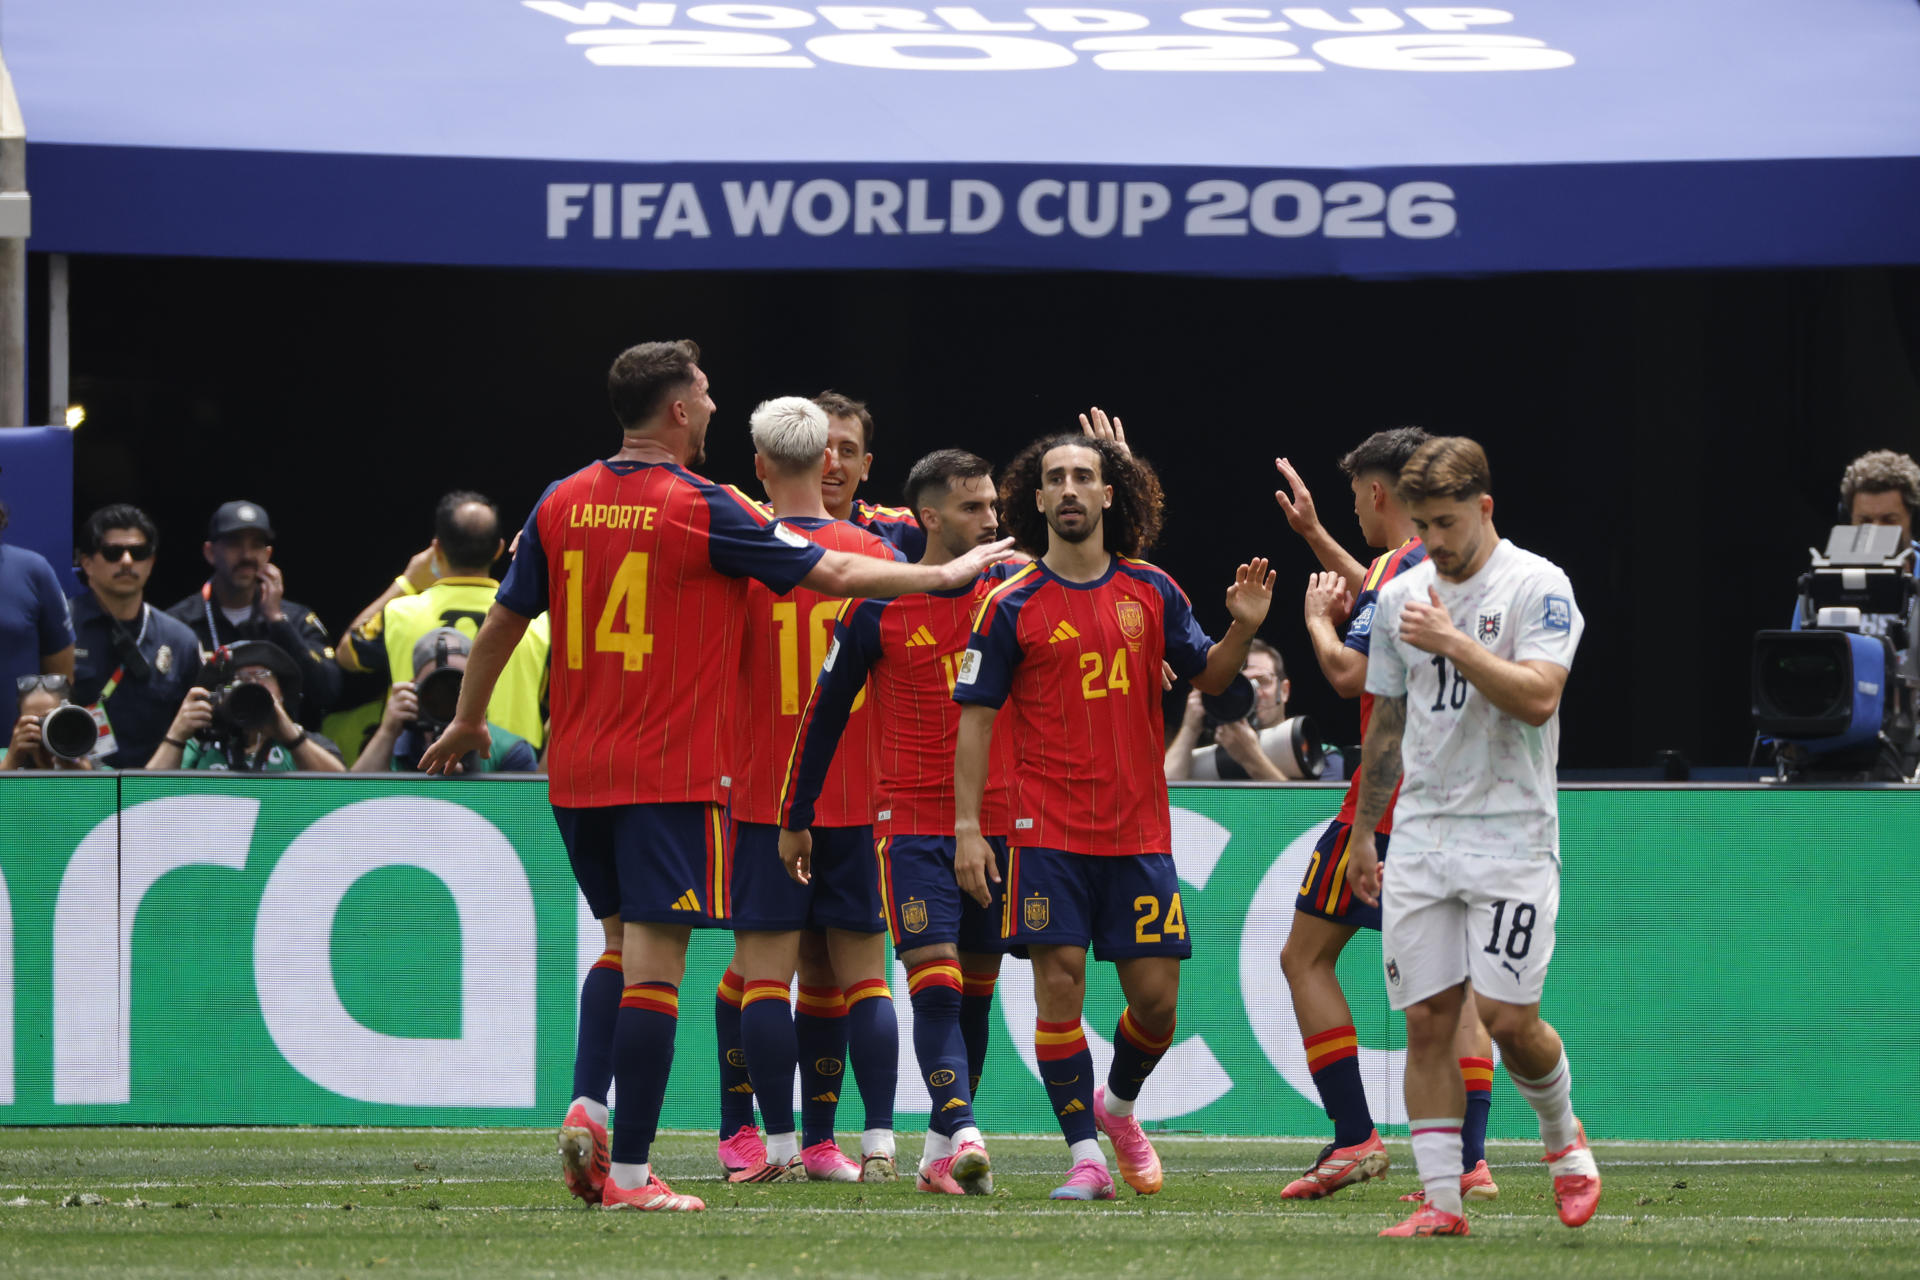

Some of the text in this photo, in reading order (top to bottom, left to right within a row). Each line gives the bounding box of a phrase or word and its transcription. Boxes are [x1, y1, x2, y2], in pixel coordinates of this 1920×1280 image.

[521, 0, 1514, 32] WORLD CUP
[565, 28, 1576, 72] 2026
[547, 179, 1456, 239] FIFA WORLD CUP 2026
[570, 503, 657, 530] LAPORTE
[563, 550, 654, 671] 14
[1079, 648, 1130, 699] 24
[1431, 655, 1467, 711] 18
[1133, 892, 1186, 943] 24
[1484, 899, 1537, 960] 18
